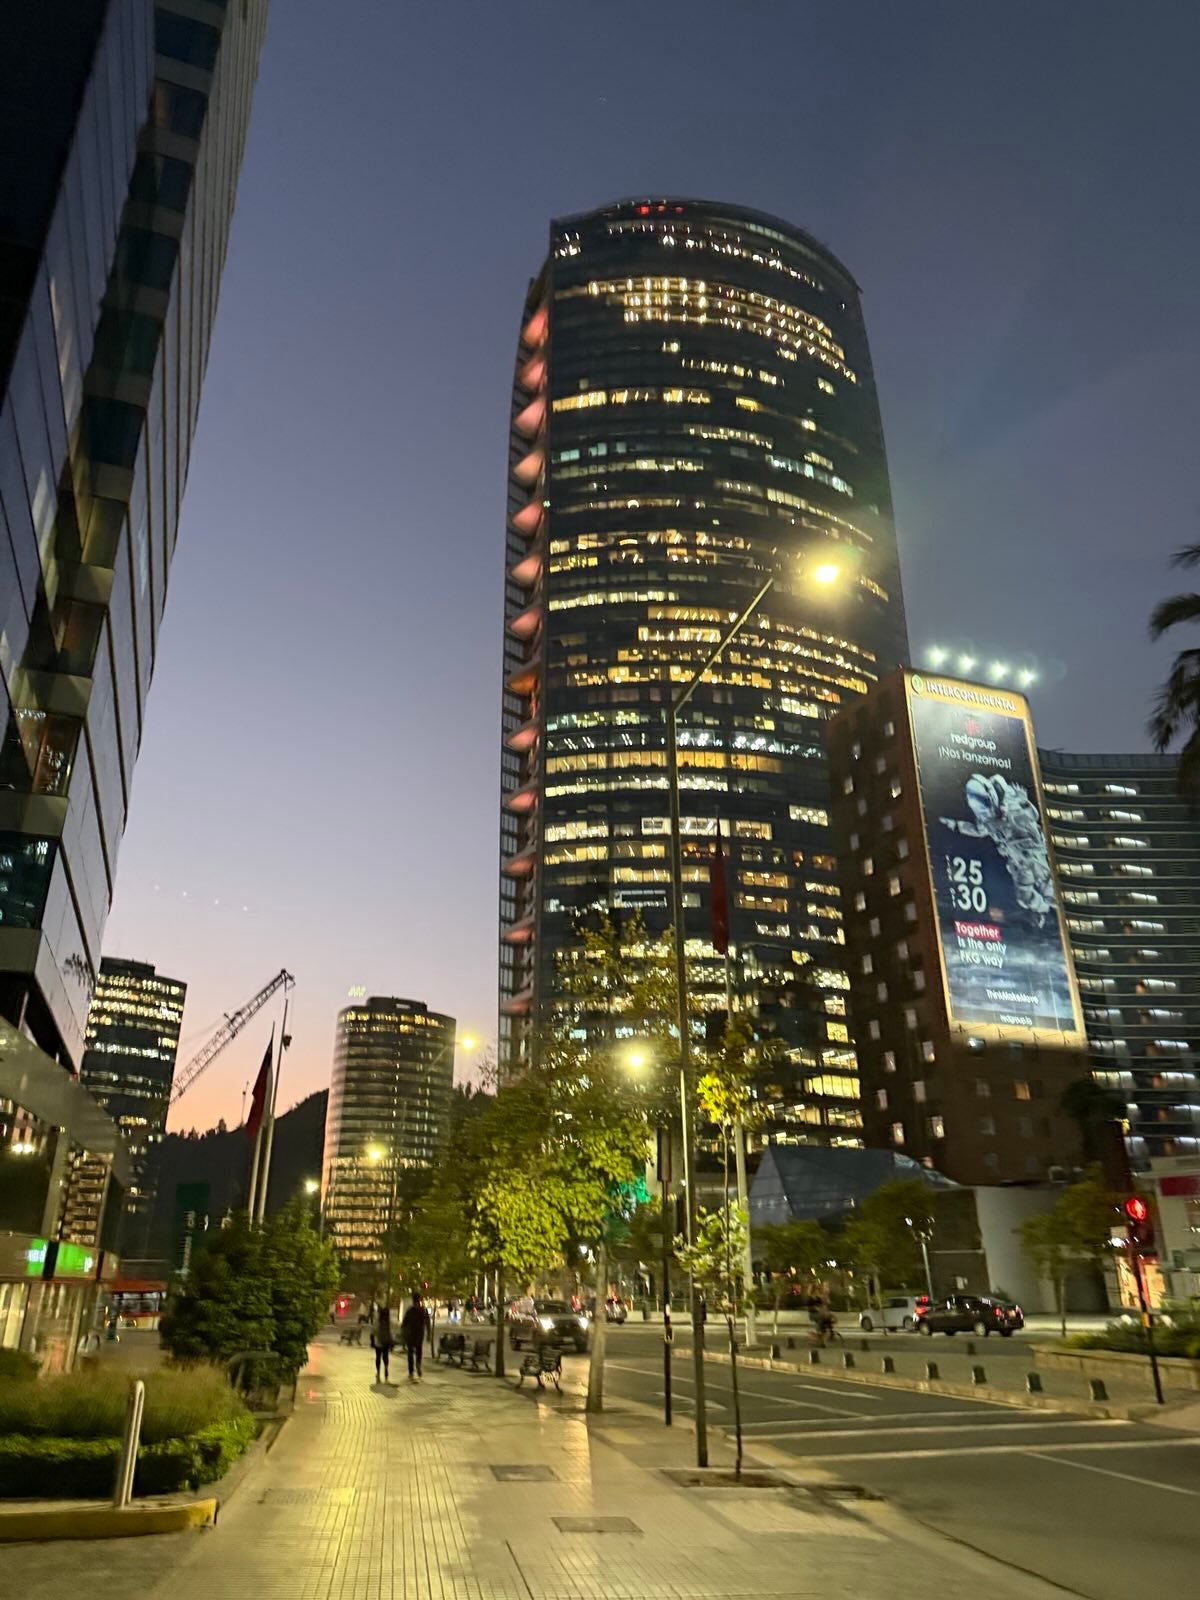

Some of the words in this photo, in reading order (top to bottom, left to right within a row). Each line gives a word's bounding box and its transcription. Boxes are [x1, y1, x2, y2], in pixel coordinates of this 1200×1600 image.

[926, 680, 1017, 712] INTERCONTINENTAL
[950, 733, 997, 752] redgroup
[952, 856, 983, 886] 25
[957, 883, 987, 913] 30
[954, 921, 1000, 939] Together
